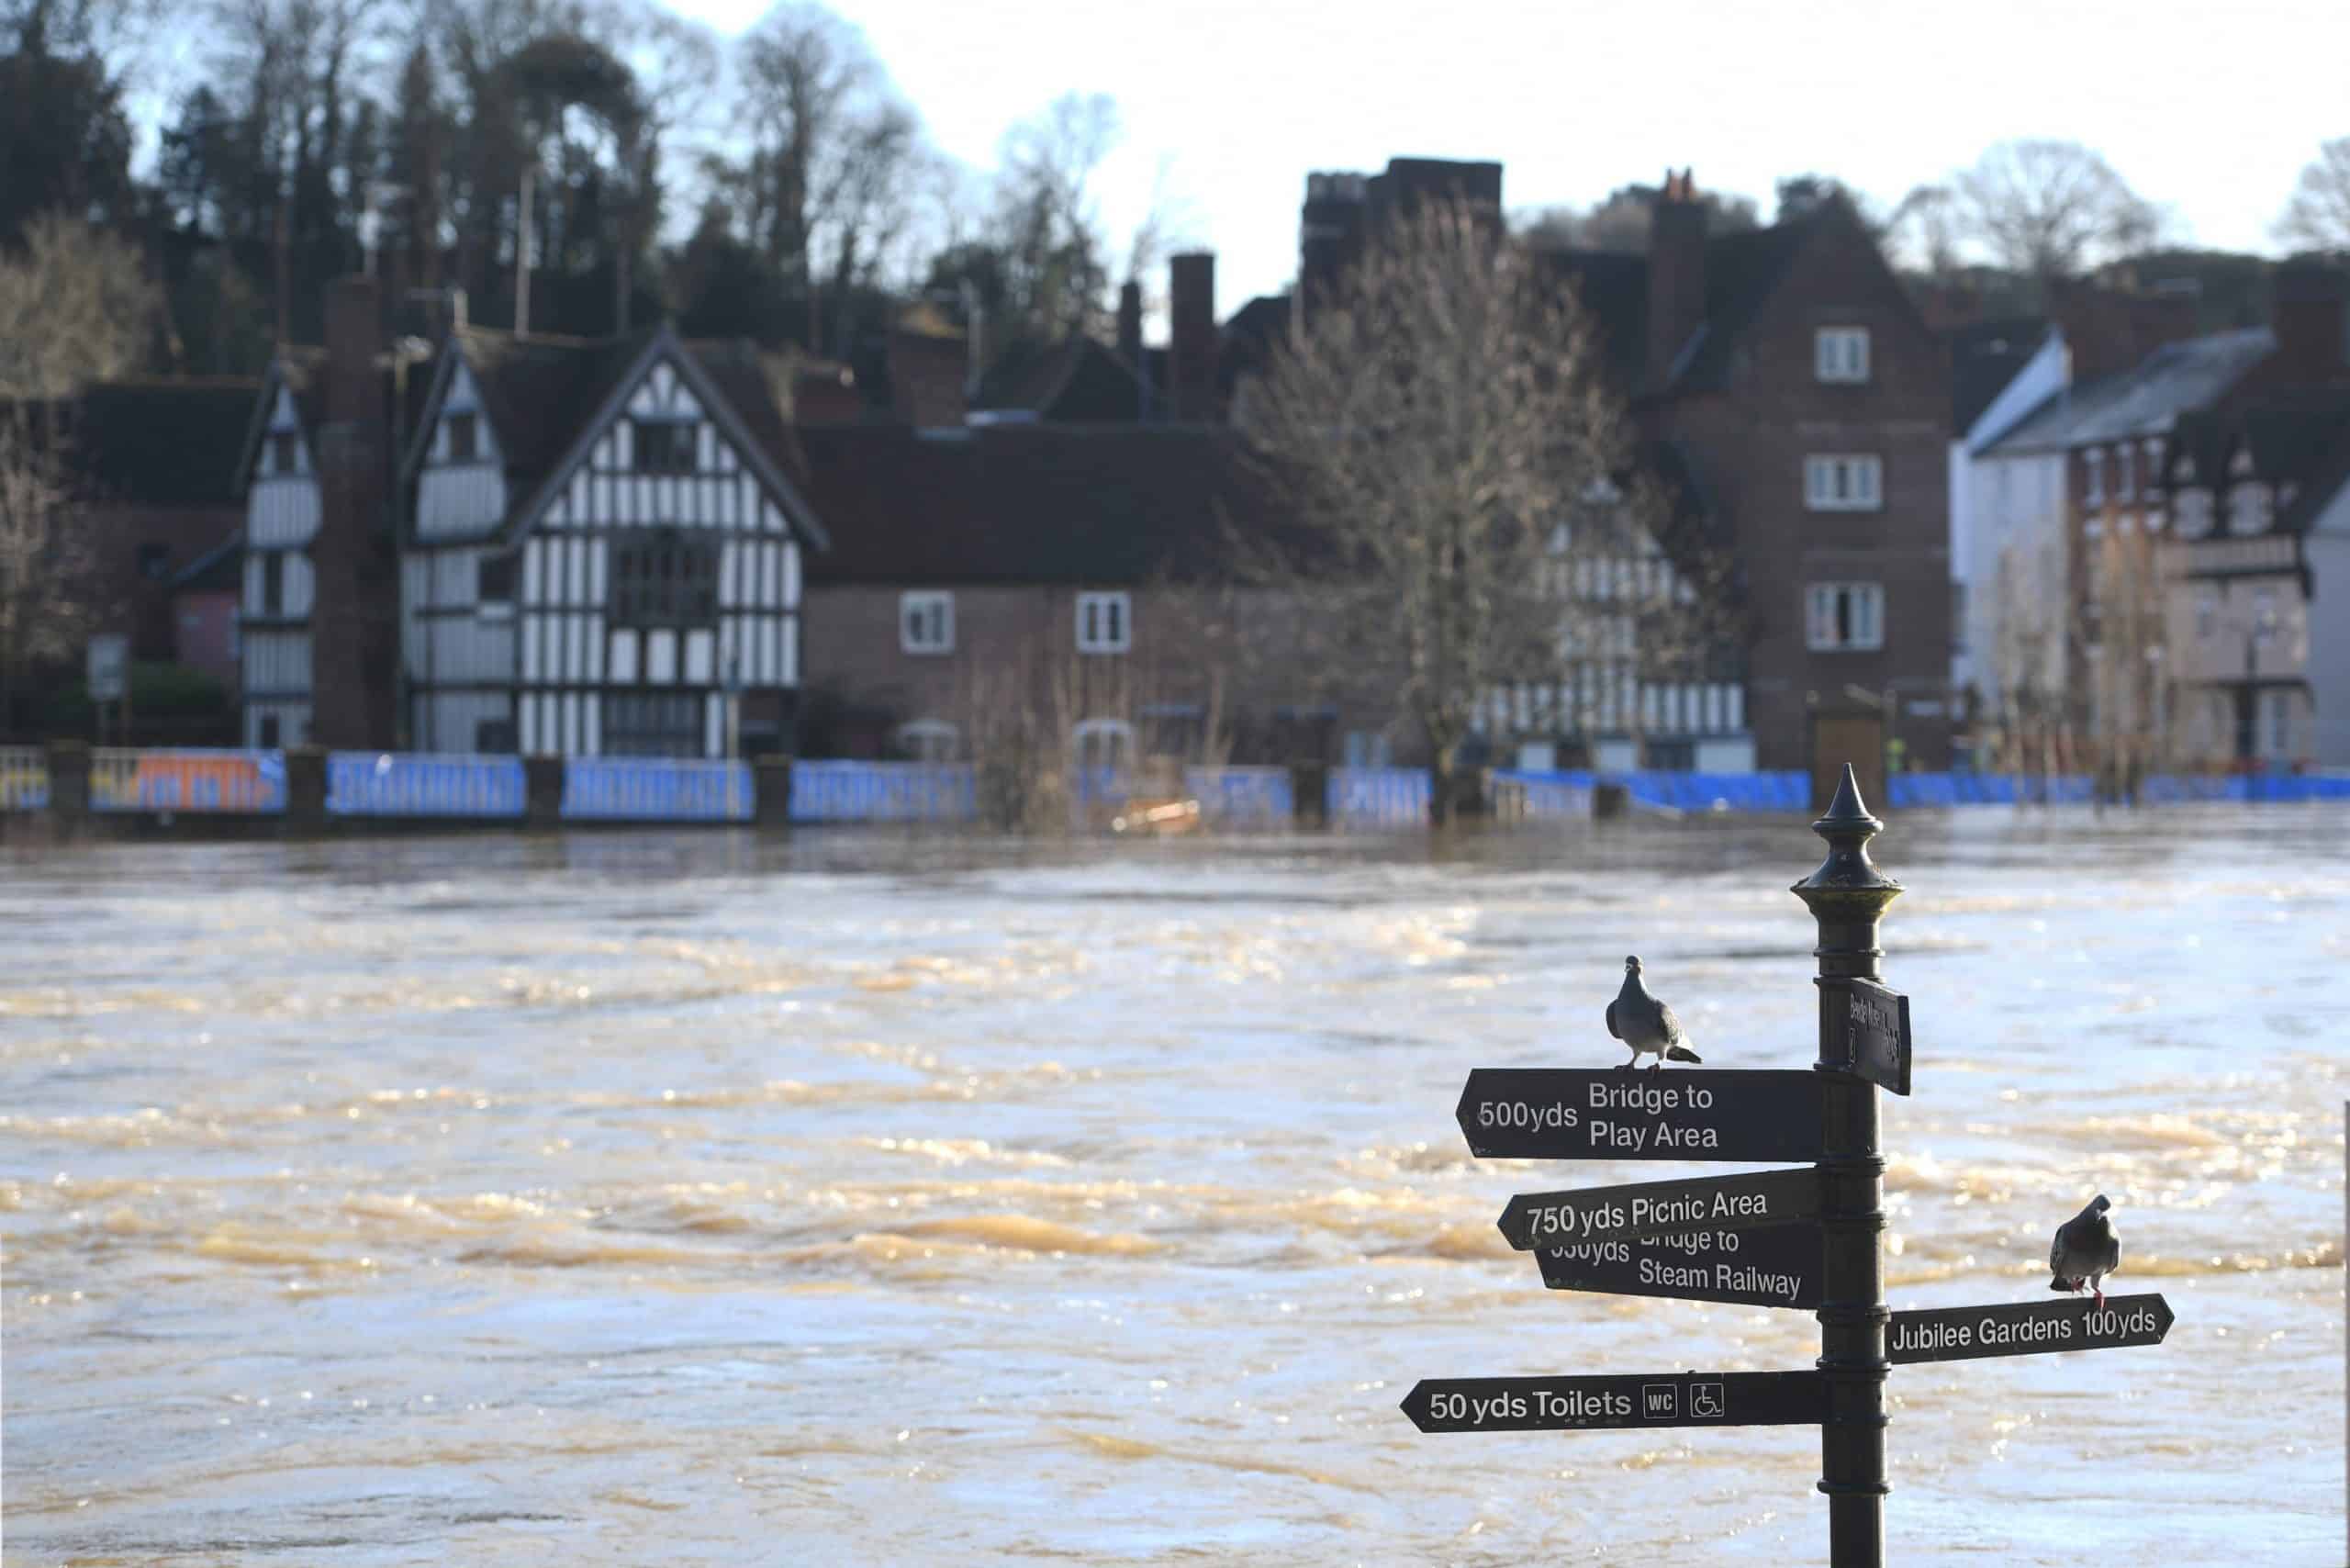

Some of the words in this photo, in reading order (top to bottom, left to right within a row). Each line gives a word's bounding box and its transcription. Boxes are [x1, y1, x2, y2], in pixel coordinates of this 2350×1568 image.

[1590, 1083, 1678, 1114] Bridge
[1685, 1085, 1712, 1108] to
[1591, 1121, 1646, 1151] Play
[1654, 1122, 1718, 1147] Area
[1528, 1204, 1574, 1238] 750
[1581, 1202, 1624, 1238] yds
[1632, 1195, 1704, 1226] Picnic
[1711, 1192, 1767, 1218] Area
[1717, 1230, 1739, 1251] to
[1640, 1259, 1707, 1288] Steam
[1717, 1264, 1800, 1300] Railway
[1893, 1323, 1971, 1350] Jubilee
[1979, 1316, 2071, 1344] Gardens
[1532, 1391, 1631, 1417] Toilets
[1649, 1394, 1672, 1410] WC
